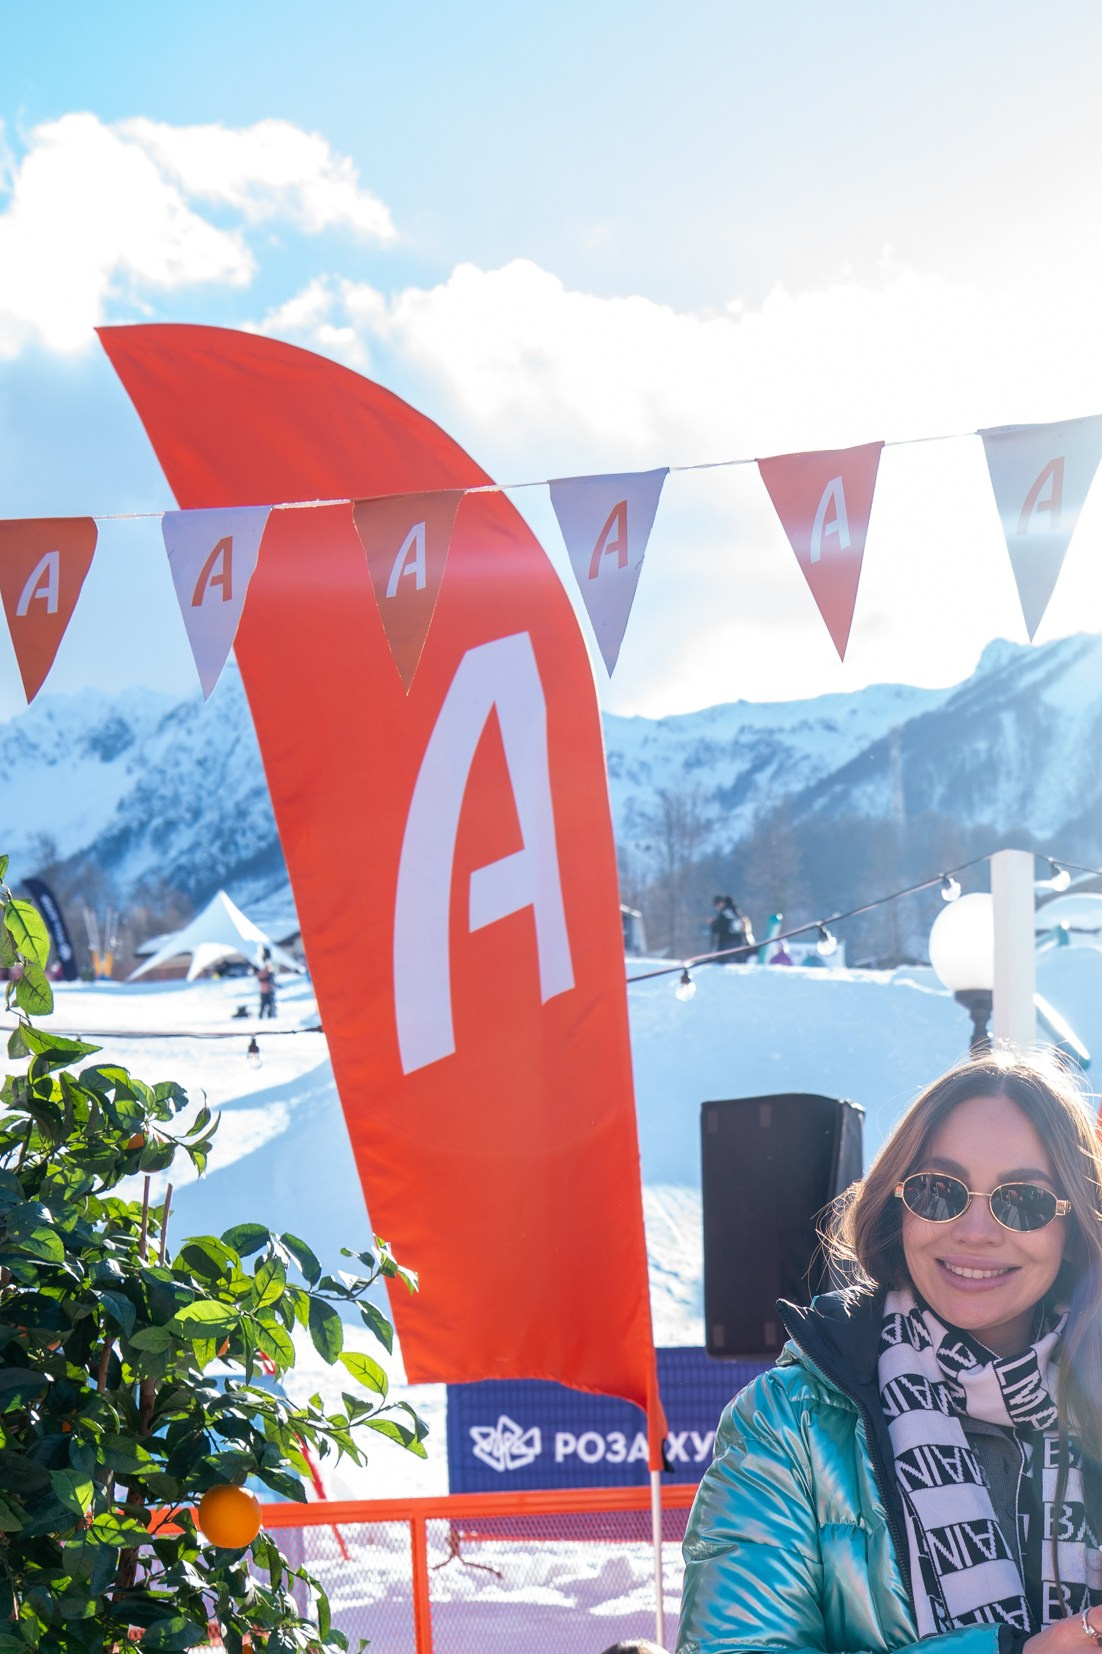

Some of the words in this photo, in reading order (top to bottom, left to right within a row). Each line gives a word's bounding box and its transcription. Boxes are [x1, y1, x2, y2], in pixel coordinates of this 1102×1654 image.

[810, 475, 852, 564] A
[1016, 456, 1065, 536] A
[191, 536, 233, 608] A
[386, 521, 427, 599] A
[588, 500, 628, 580] A
[16, 551, 60, 617] A
[393, 631, 575, 1075] A
[554, 1431, 650, 1464] РОЗА
